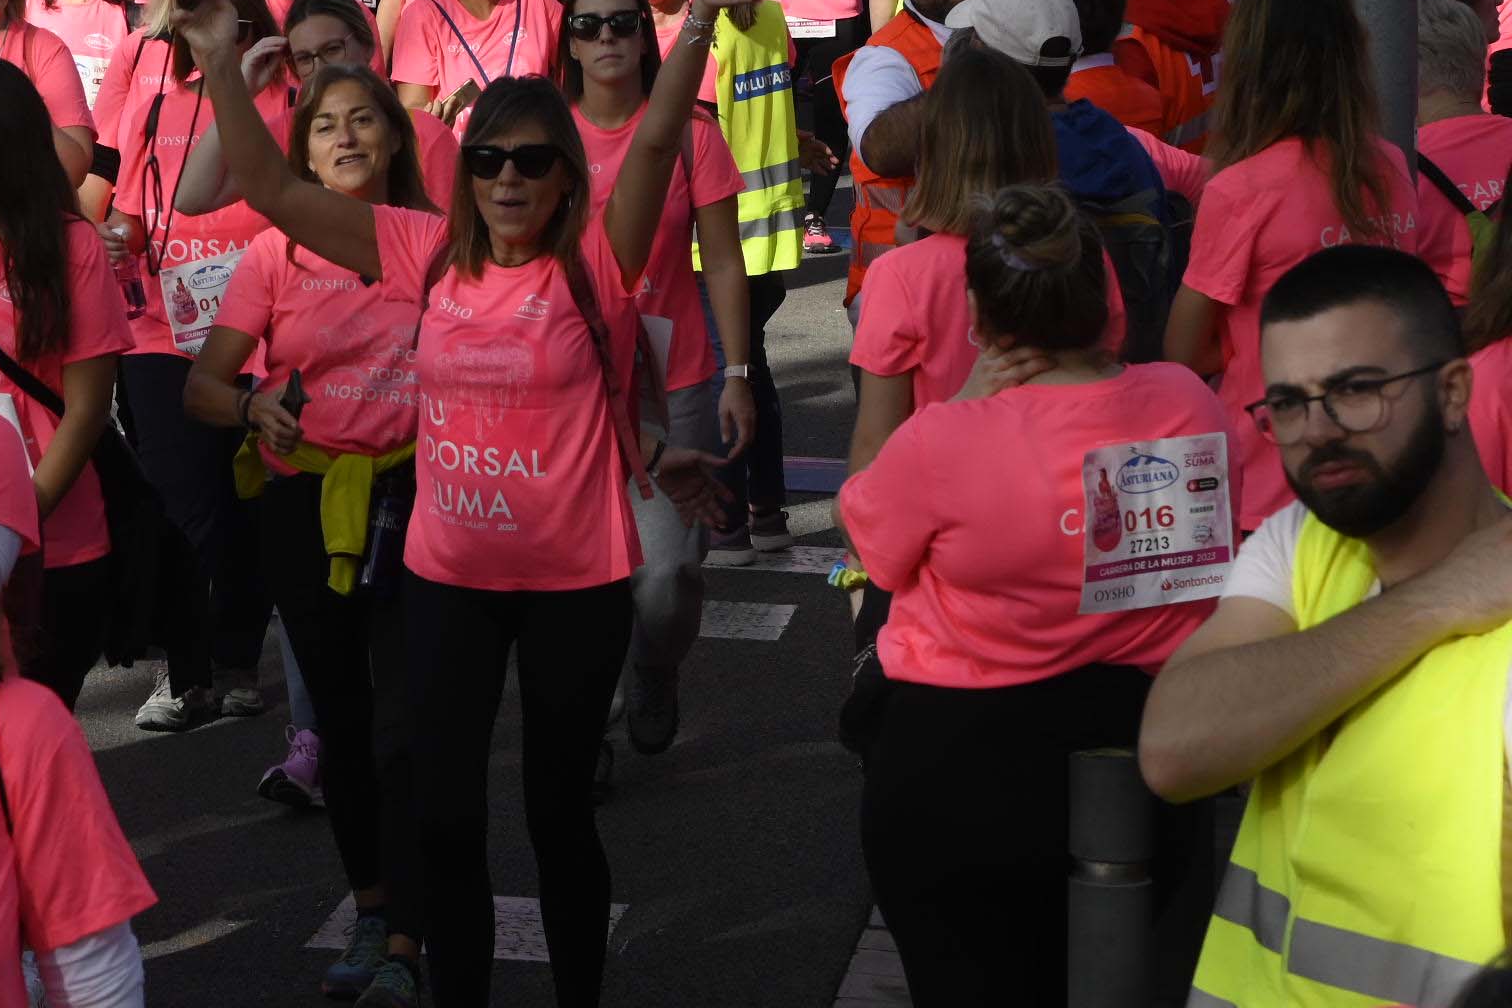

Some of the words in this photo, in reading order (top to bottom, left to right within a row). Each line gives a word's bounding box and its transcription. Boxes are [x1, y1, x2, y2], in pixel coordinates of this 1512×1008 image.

[302, 278, 358, 291] OYSHO
[426, 439, 548, 479] DORSAL
[1184, 456, 1216, 468] SUMA
[1120, 470, 1174, 488] ASTURIANA
[1124, 505, 1175, 533] 016
[1130, 536, 1170, 554] 27213
[1099, 565, 1133, 578] CARRERA
[1134, 562, 1146, 572] DE
[1147, 560, 1159, 570] LA
[1161, 556, 1193, 568] MUJER
[1173, 574, 1224, 591] Santander
[1094, 584, 1136, 603] OYSHO
